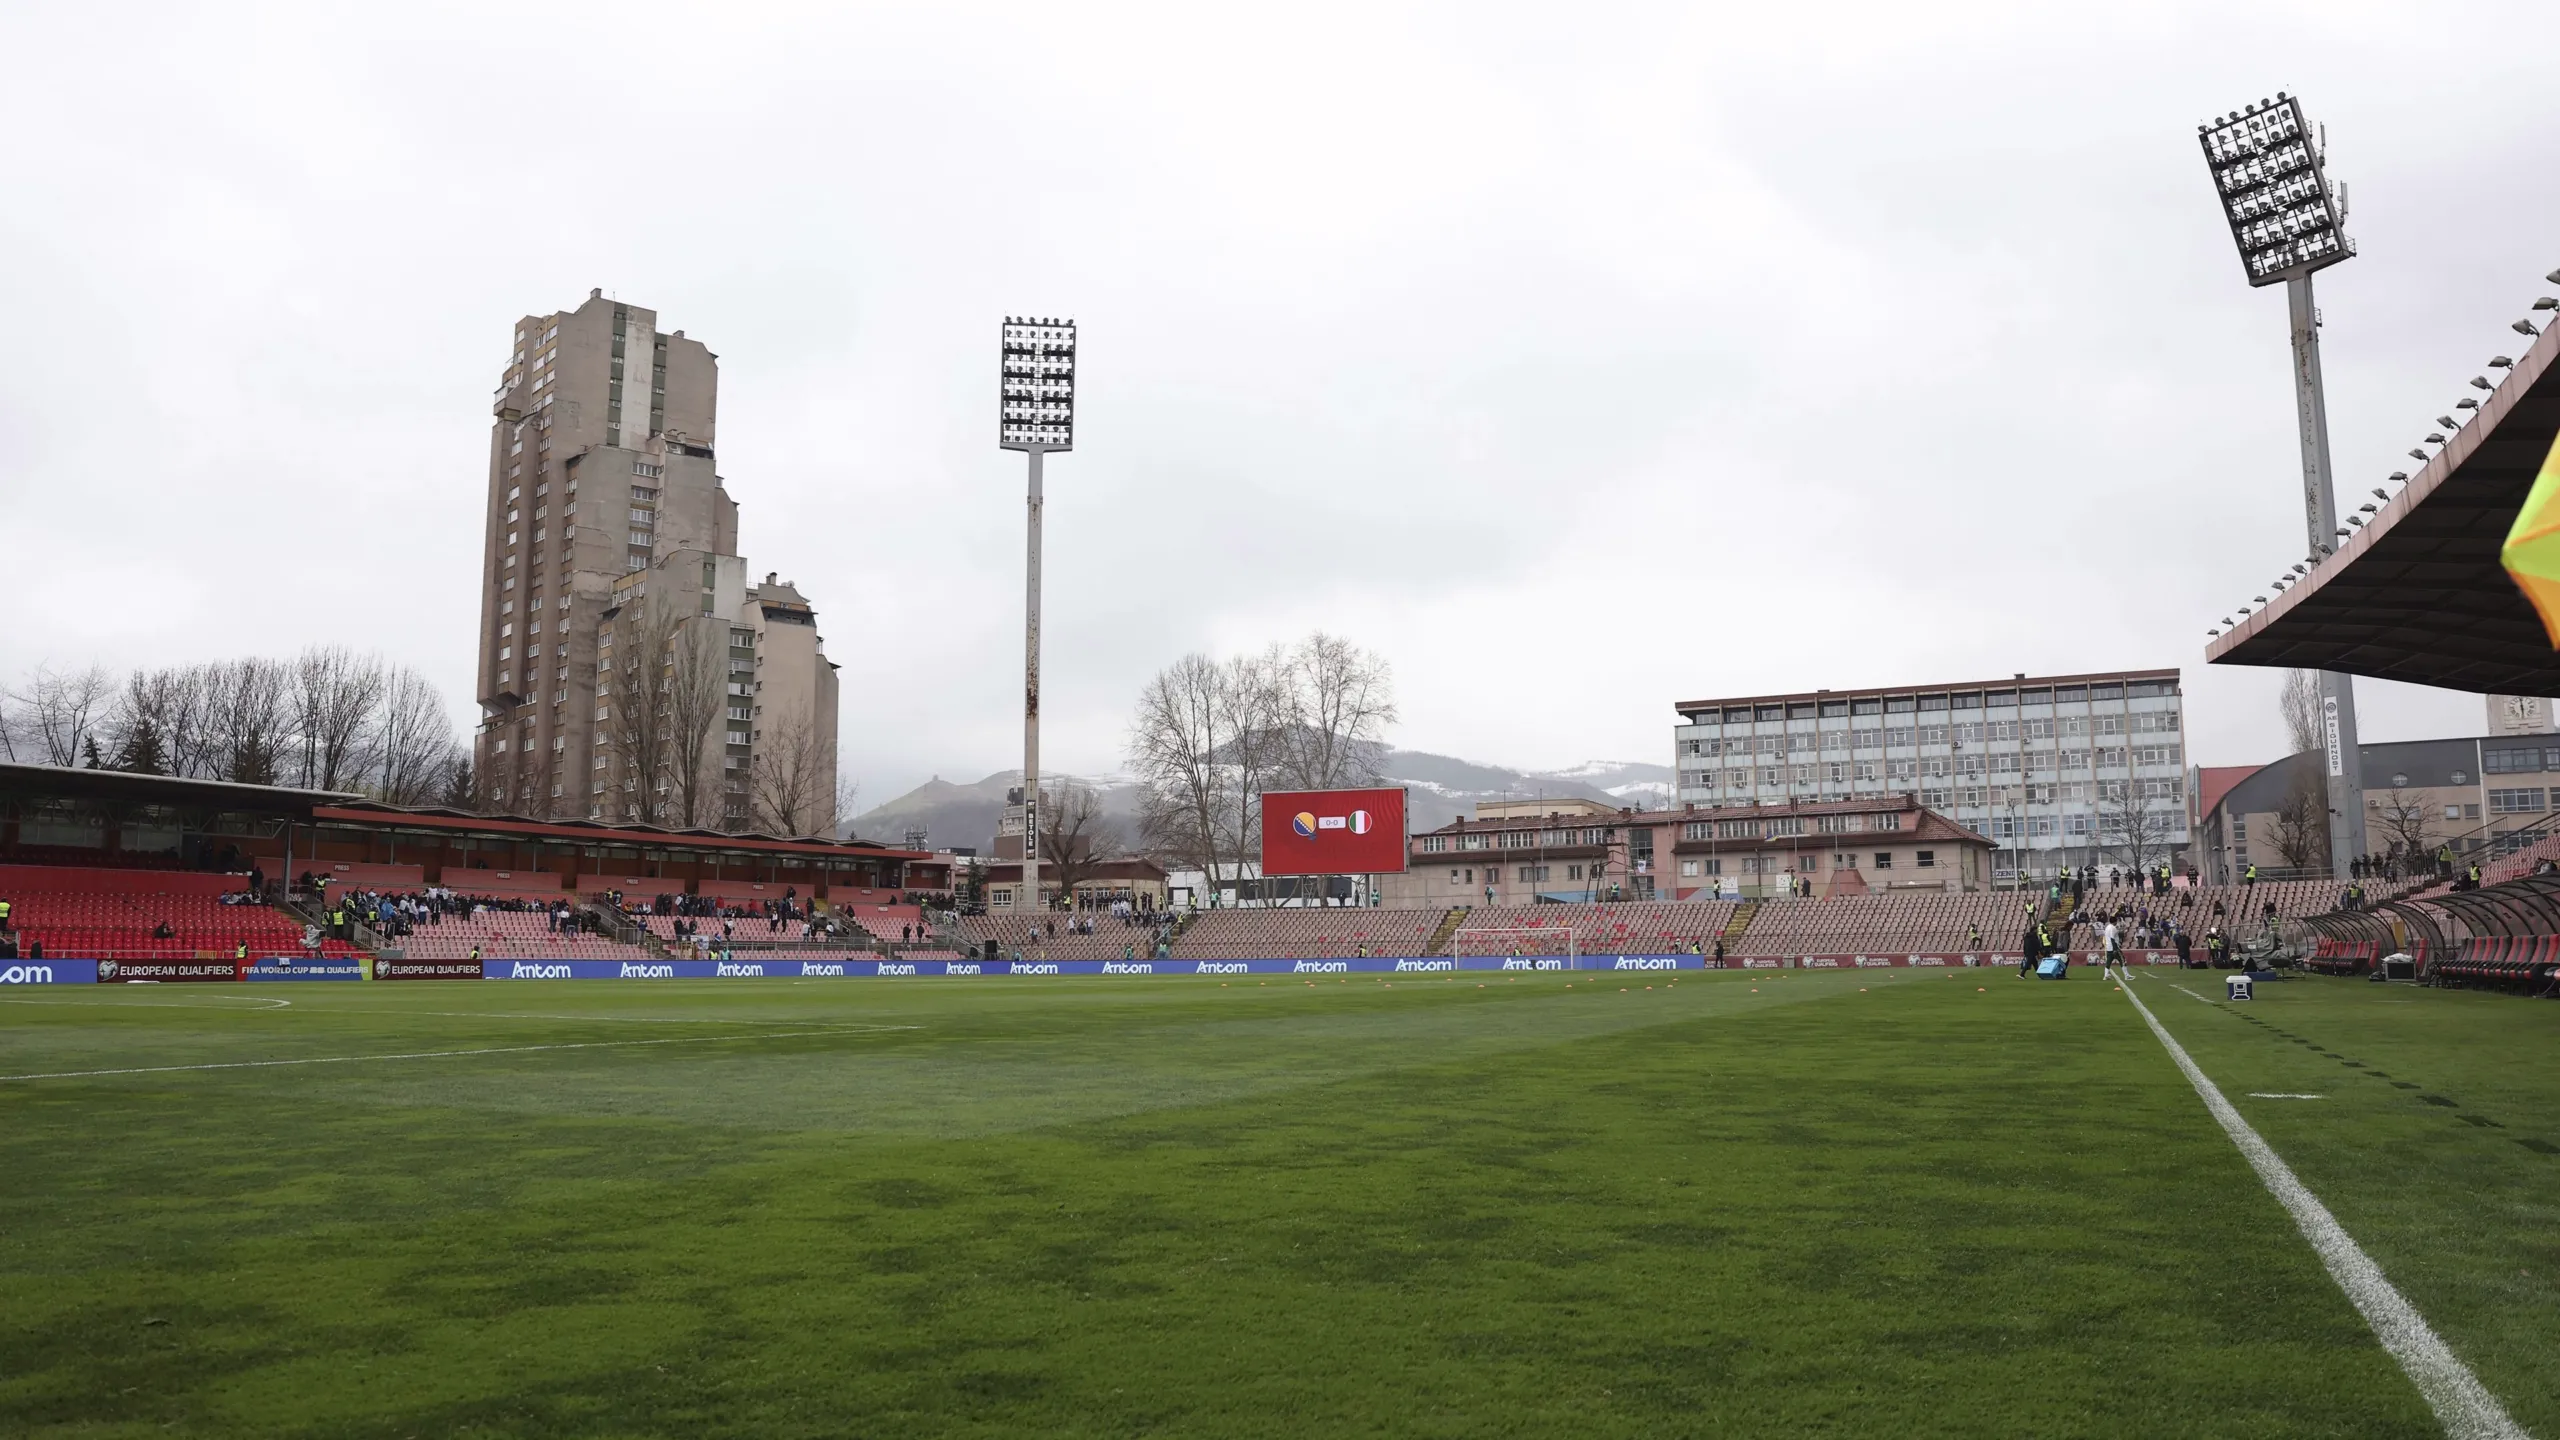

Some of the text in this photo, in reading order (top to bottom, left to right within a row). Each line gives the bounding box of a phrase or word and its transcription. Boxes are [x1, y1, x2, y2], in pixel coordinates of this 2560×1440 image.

[1325, 819, 1339, 827] 0-0
[391, 965, 481, 974] EUROPEAN QUALIFIERS
[511, 961, 571, 978] Antom
[620, 961, 673, 978] Antom
[716, 961, 764, 977] Antom
[801, 961, 844, 976] Antom
[877, 961, 916, 976] Antom
[946, 961, 981, 975] Antom
[1010, 961, 1058, 975] Antom
[1102, 961, 1152, 974] Antom
[1196, 960, 1248, 974] Antom
[1293, 959, 1347, 973] Antom
[1395, 958, 1452, 972] Antom
[1502, 957, 1562, 970] Antom
[1614, 955, 1677, 970] Antom
[0, 966, 52, 983] om
[120, 965, 235, 976] EUROPEAN QUALIFIERS
[241, 966, 260, 974] FIFA
[260, 966, 291, 974] WORLD
[292, 966, 309, 974] CUP
[326, 966, 369, 974] QUALIFIERS
